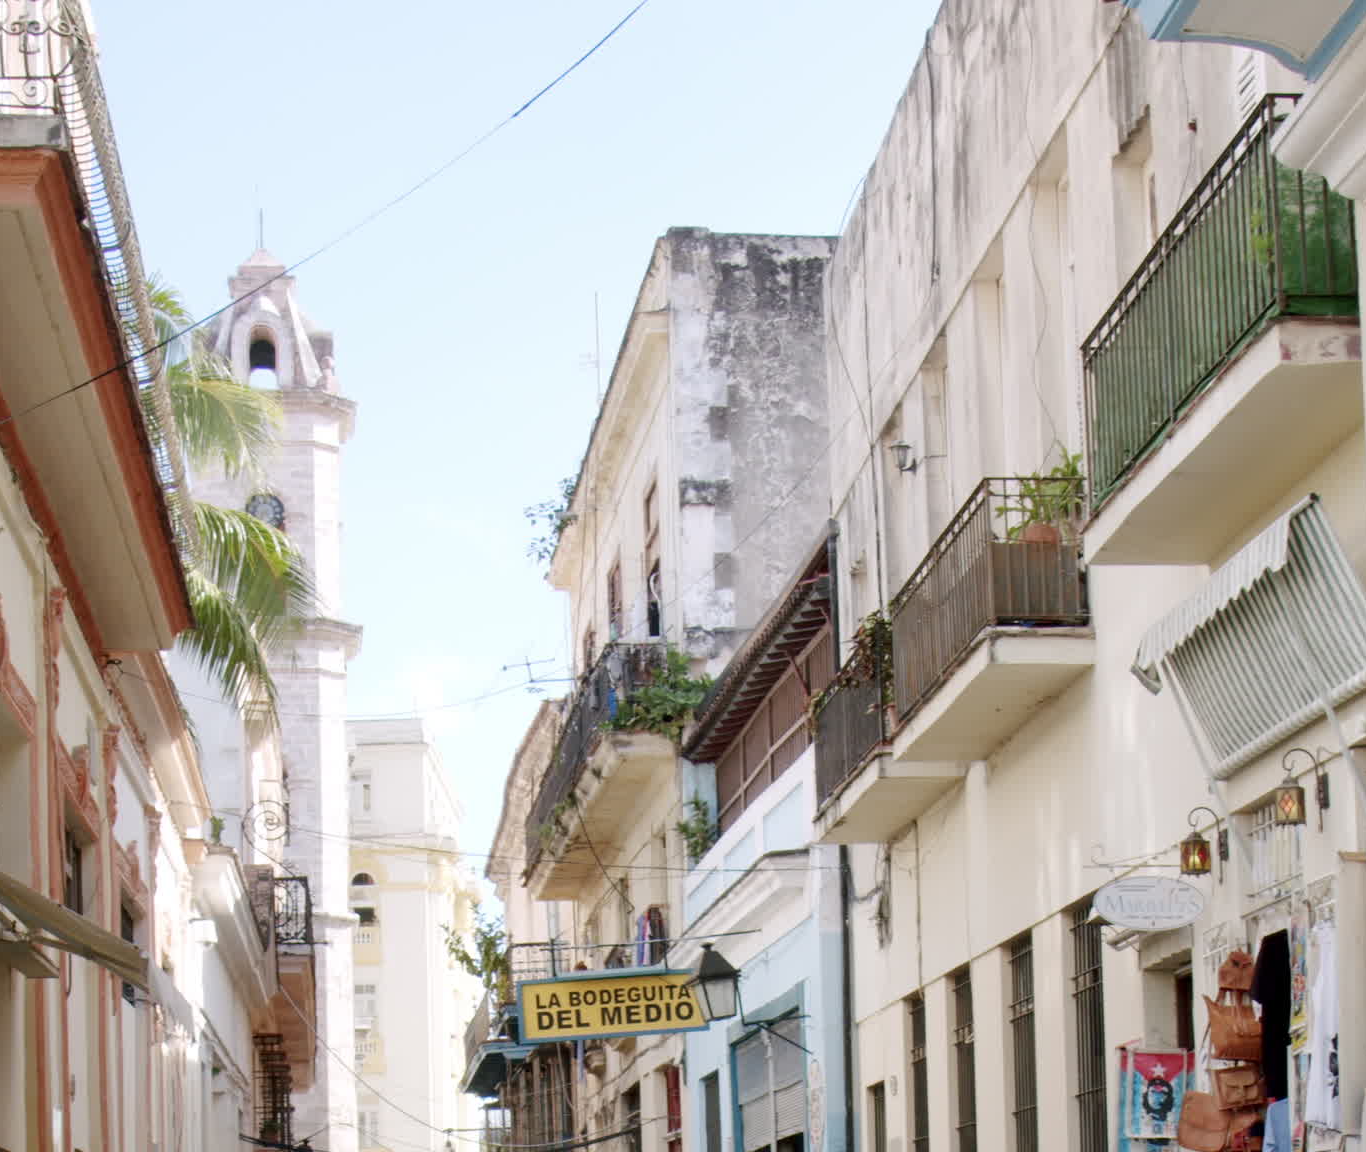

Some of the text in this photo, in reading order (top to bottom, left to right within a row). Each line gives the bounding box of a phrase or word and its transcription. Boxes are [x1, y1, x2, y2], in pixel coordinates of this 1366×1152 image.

[536, 984, 692, 1010] LA BODEGUITA
[537, 1001, 694, 1031] DEL MEDIO
